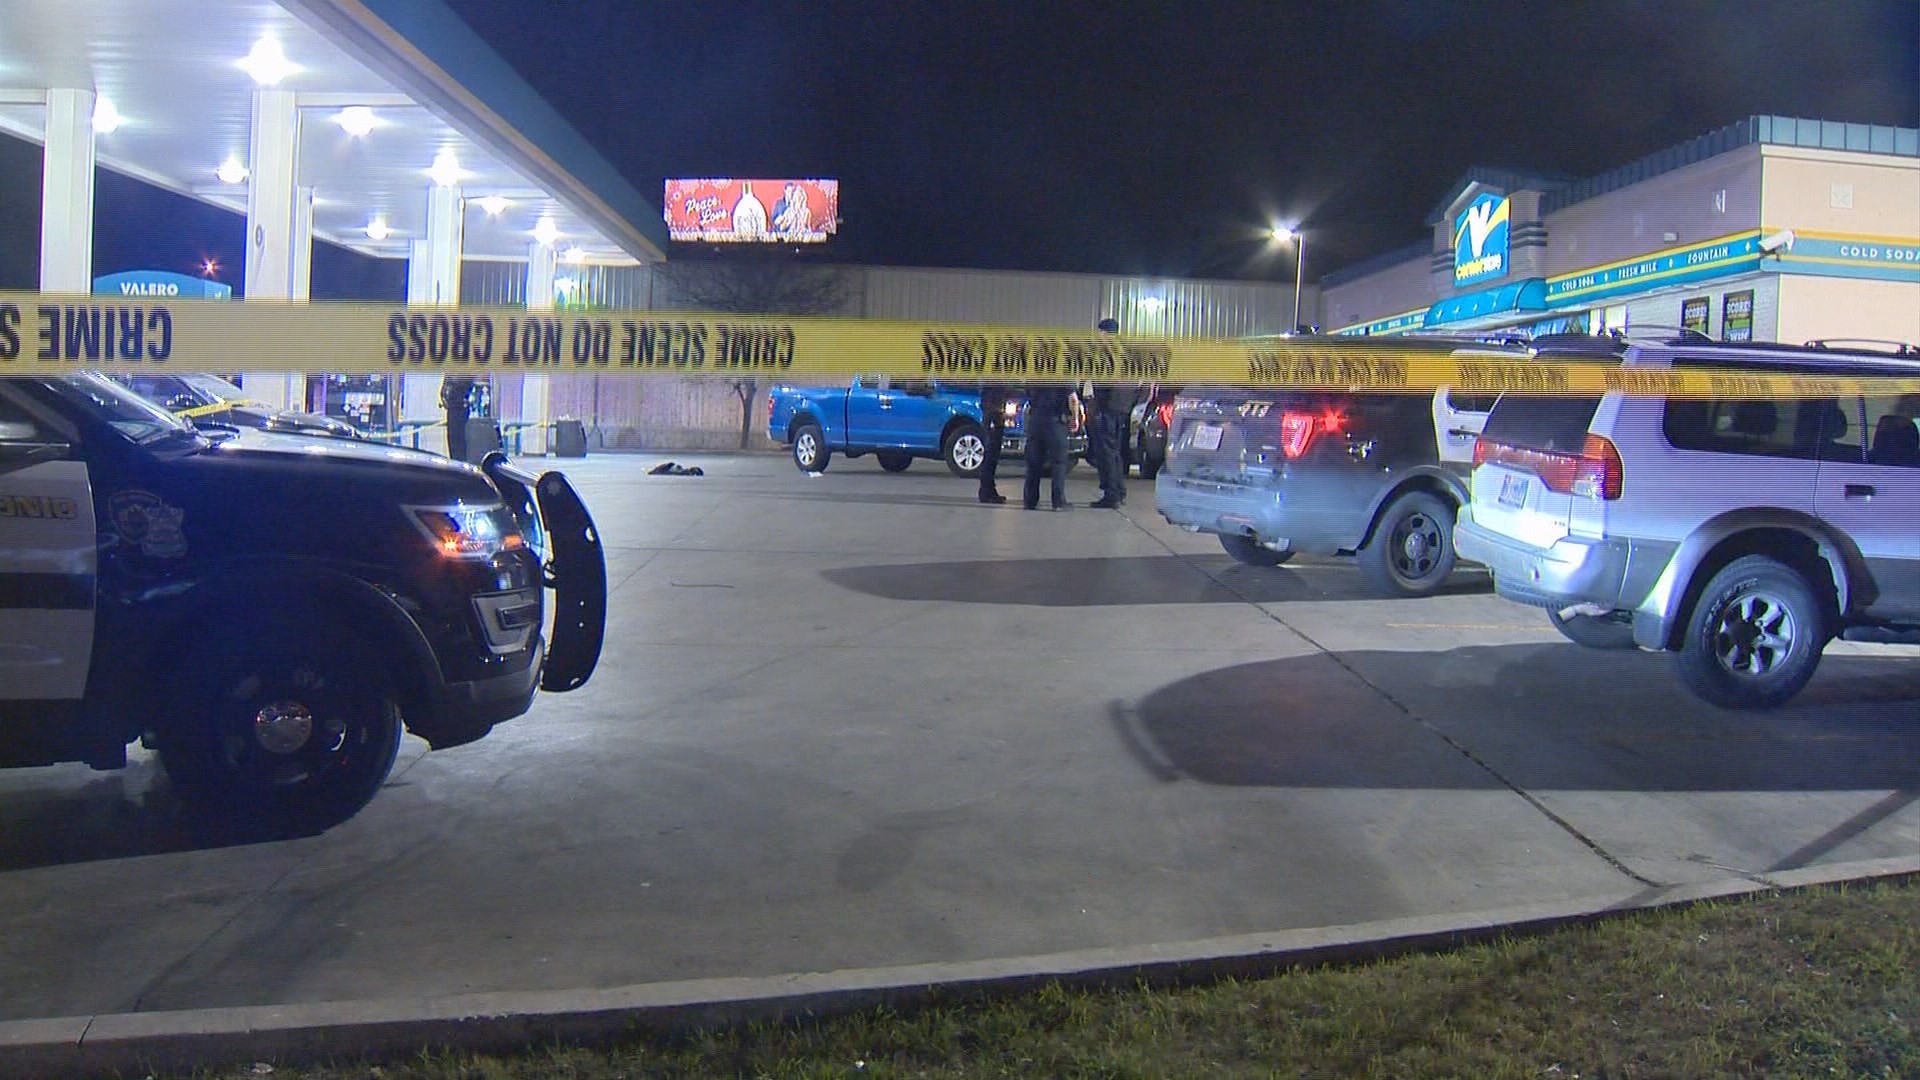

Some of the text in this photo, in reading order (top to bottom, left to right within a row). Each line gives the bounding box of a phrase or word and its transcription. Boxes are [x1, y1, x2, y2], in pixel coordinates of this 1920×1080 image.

[1687, 246, 1729, 264] FOUNTAIN
[1840, 246, 1878, 258] COLD
[120, 282, 179, 297] VALERO
[38, 304, 172, 363] CRIME
[387, 312, 796, 370] CRIME SCENE DO NOT CROSS
[921, 330, 987, 373] CROSS
